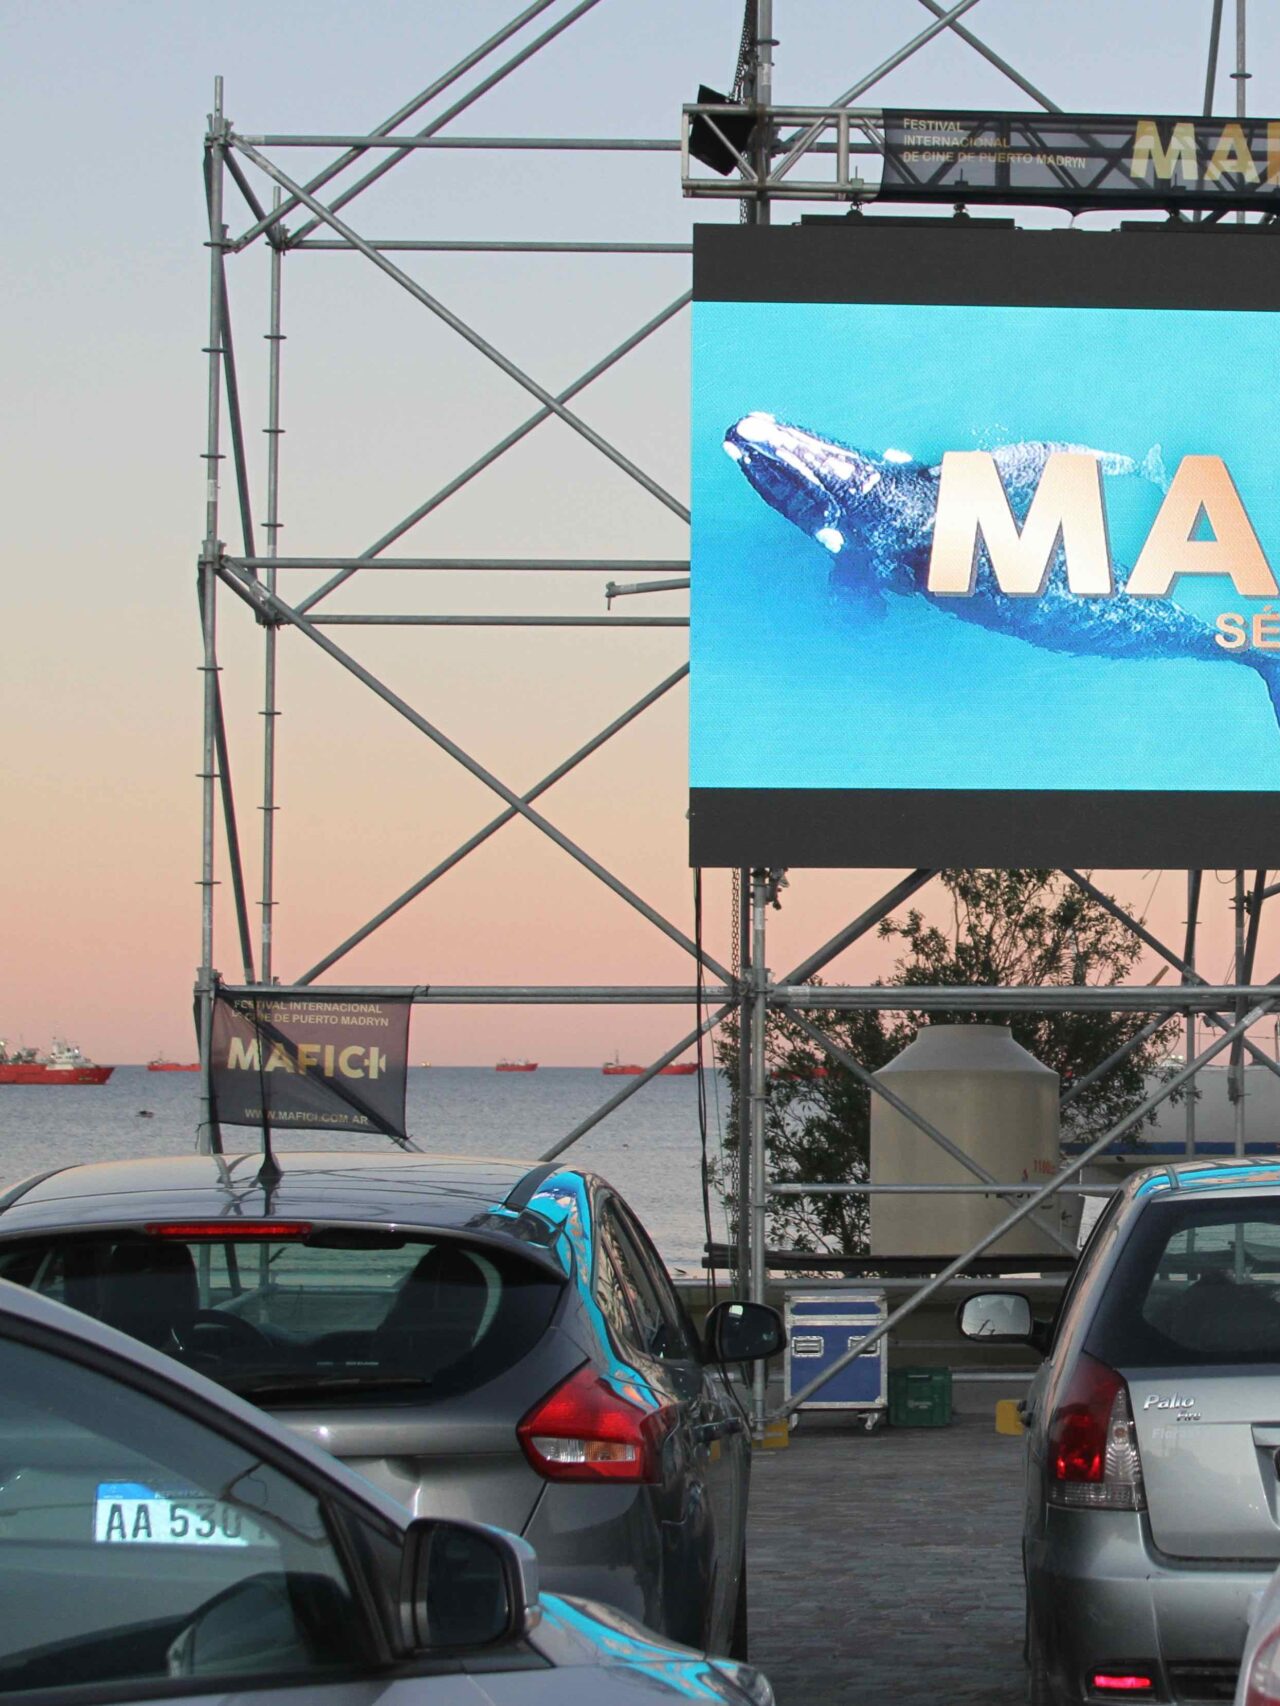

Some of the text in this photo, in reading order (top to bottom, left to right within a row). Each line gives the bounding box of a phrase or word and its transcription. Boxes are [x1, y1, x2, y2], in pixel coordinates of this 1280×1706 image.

[903, 117, 964, 132] FESTIVAL
[903, 134, 1010, 148] INTERNACIONAL
[903, 150, 1086, 169] DE CINE DE PUERTO MADRYN
[290, 1001, 383, 1014] INTERNACIONAL
[274, 1013, 290, 1023] DE
[292, 1014, 339, 1025] PUERTO
[341, 1015, 389, 1027] MADRYN
[1143, 1392, 1195, 1410] Palio
[106, 1502, 152, 1540] AA
[169, 1502, 242, 1540] 530
